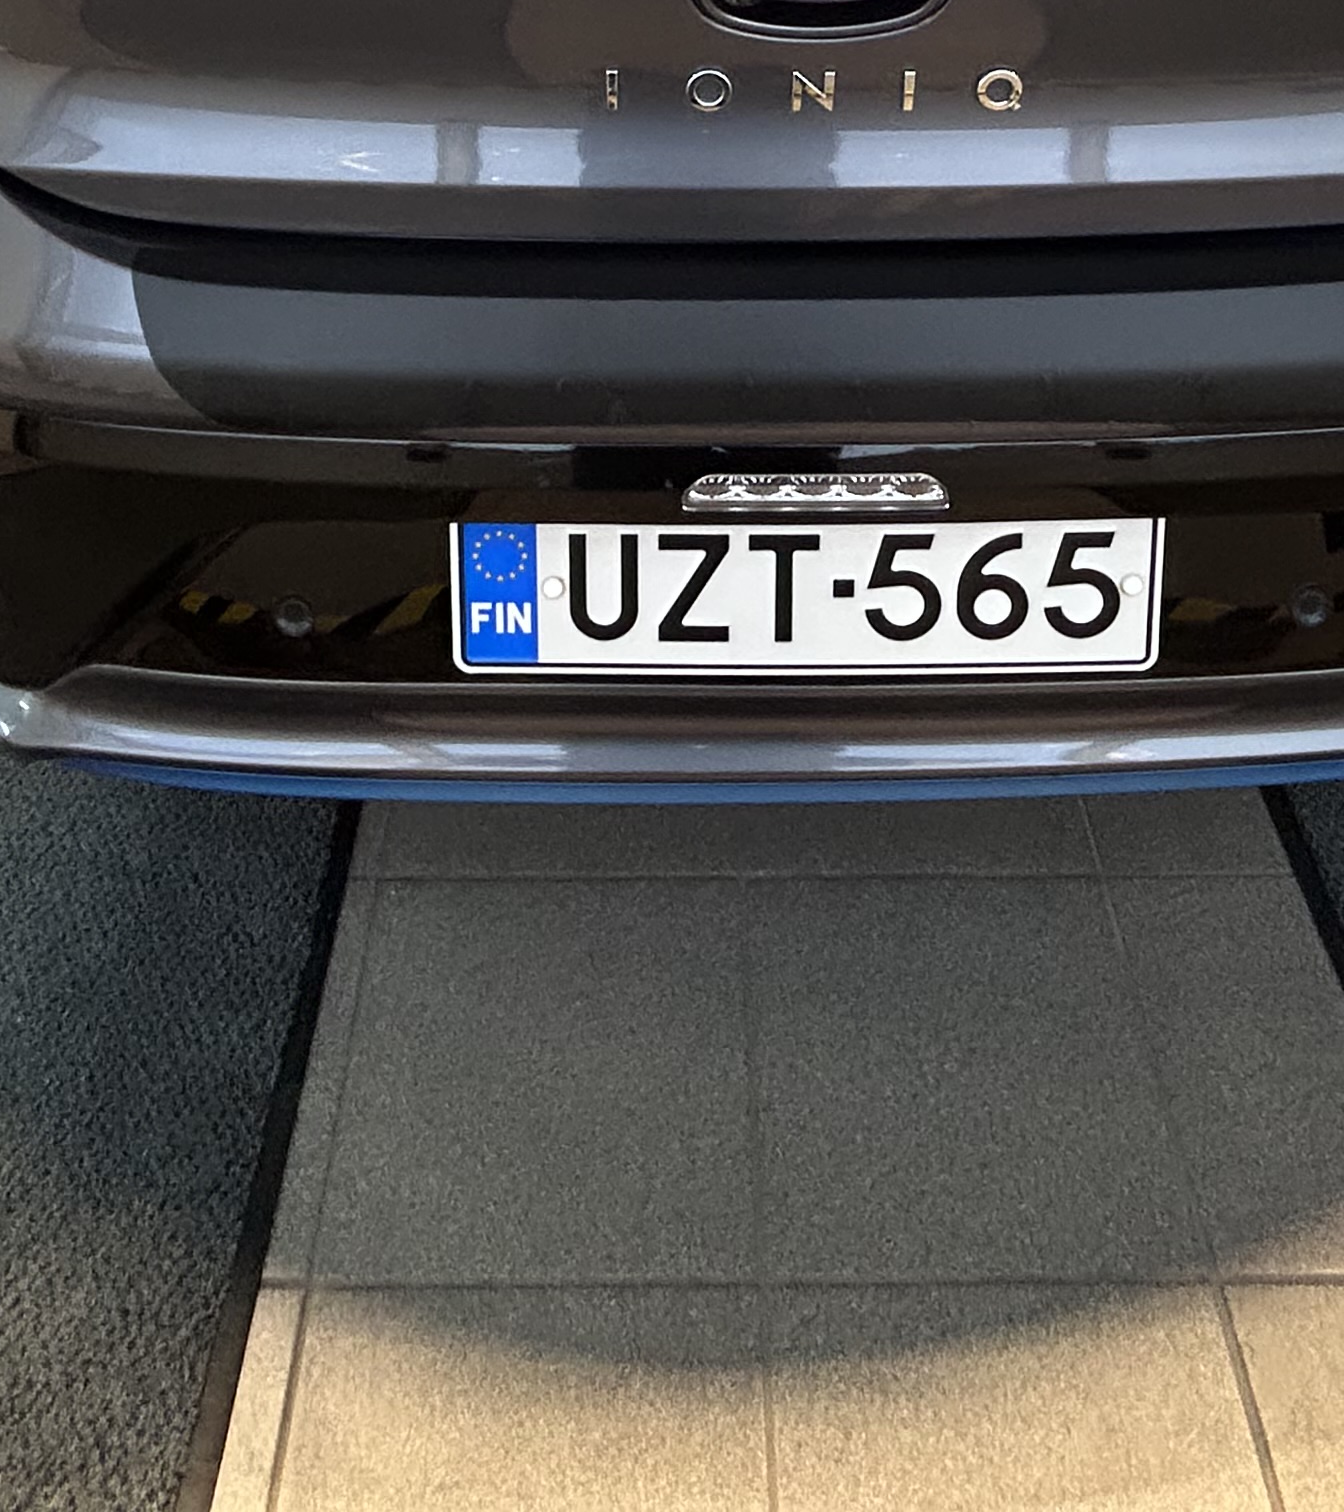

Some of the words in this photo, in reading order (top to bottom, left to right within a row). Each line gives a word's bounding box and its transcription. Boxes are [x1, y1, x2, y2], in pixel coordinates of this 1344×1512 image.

[605, 68, 1023, 112] IONIQ
[567, 531, 1121, 642] UZT-565
[471, 602, 532, 635] FIN
